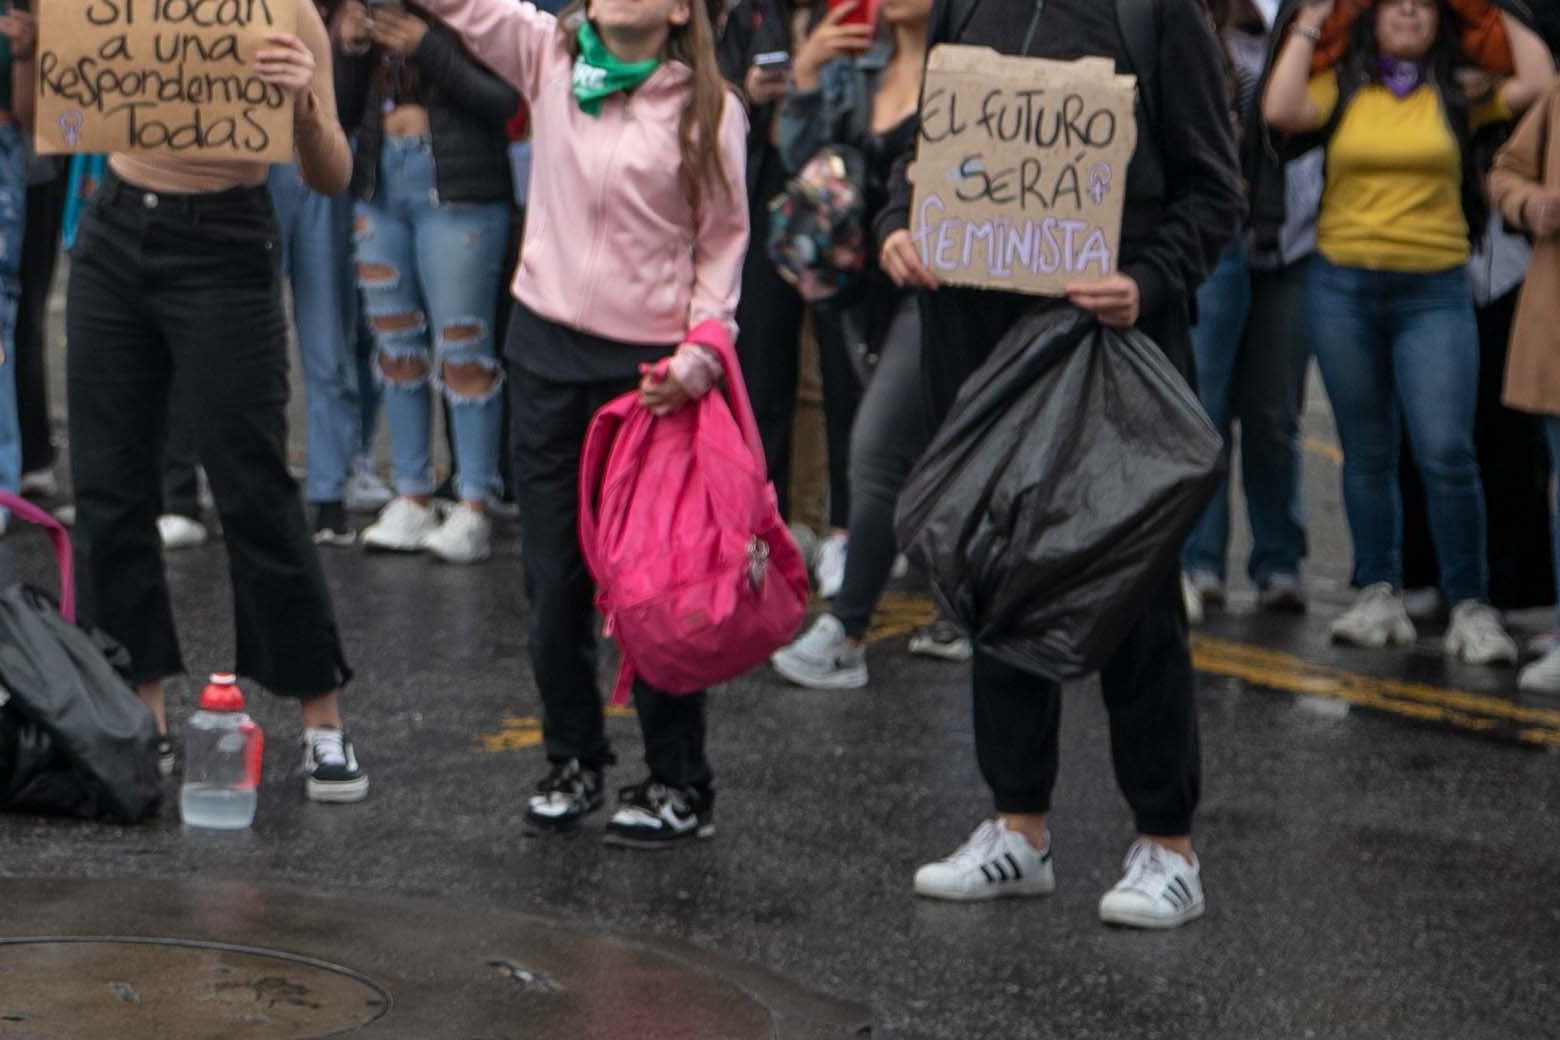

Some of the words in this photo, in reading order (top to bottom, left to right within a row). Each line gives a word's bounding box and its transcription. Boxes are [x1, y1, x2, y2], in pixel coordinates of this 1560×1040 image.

[98, 33, 132, 62] a
[154, 32, 245, 66] una
[919, 89, 967, 143] EL
[955, 151, 1087, 210] SERÁ
